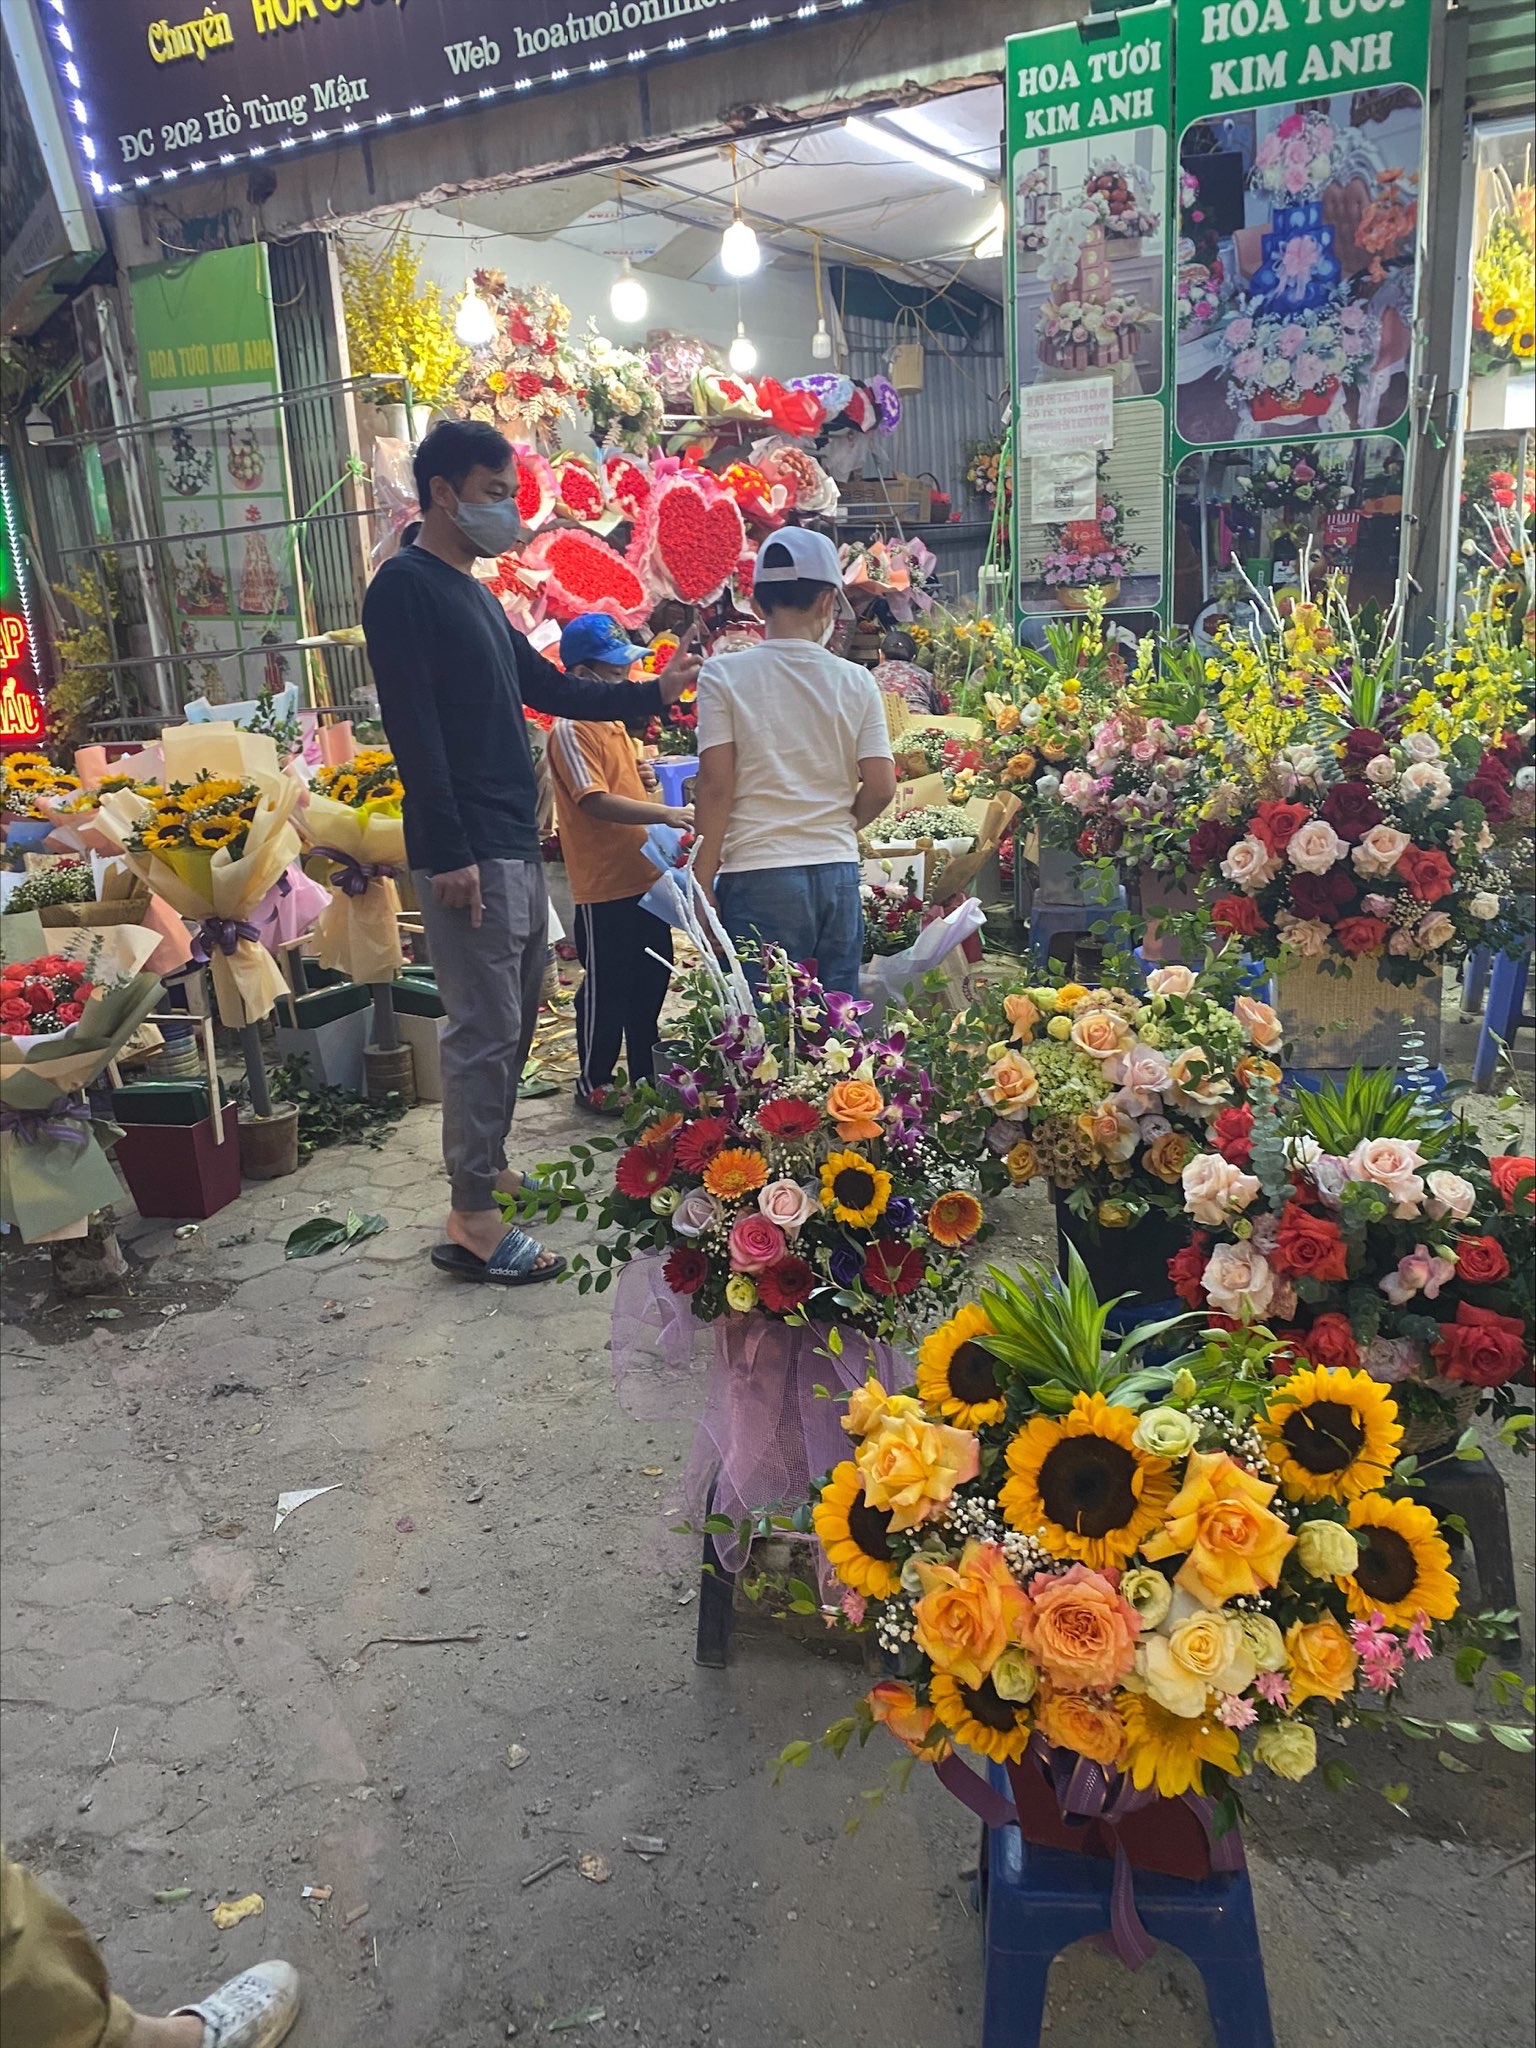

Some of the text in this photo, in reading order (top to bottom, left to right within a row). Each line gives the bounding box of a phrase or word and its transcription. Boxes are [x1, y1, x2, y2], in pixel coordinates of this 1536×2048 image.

[1201, 0, 1290, 44] HOA
[444, 36, 500, 75] Web
[1017, 37, 1162, 98] HOA TƯƠI
[1209, 31, 1394, 100] KIM ANH
[118, 74, 370, 162] ĐC 202 Hồ Tùng Mậu
[1025, 88, 1154, 139] KIM ANH
[149, 349, 177, 379] HOA
[211, 341, 240, 374] KIM
[243, 338, 275, 371] ANH
[489, 1267, 519, 1277] adidas
